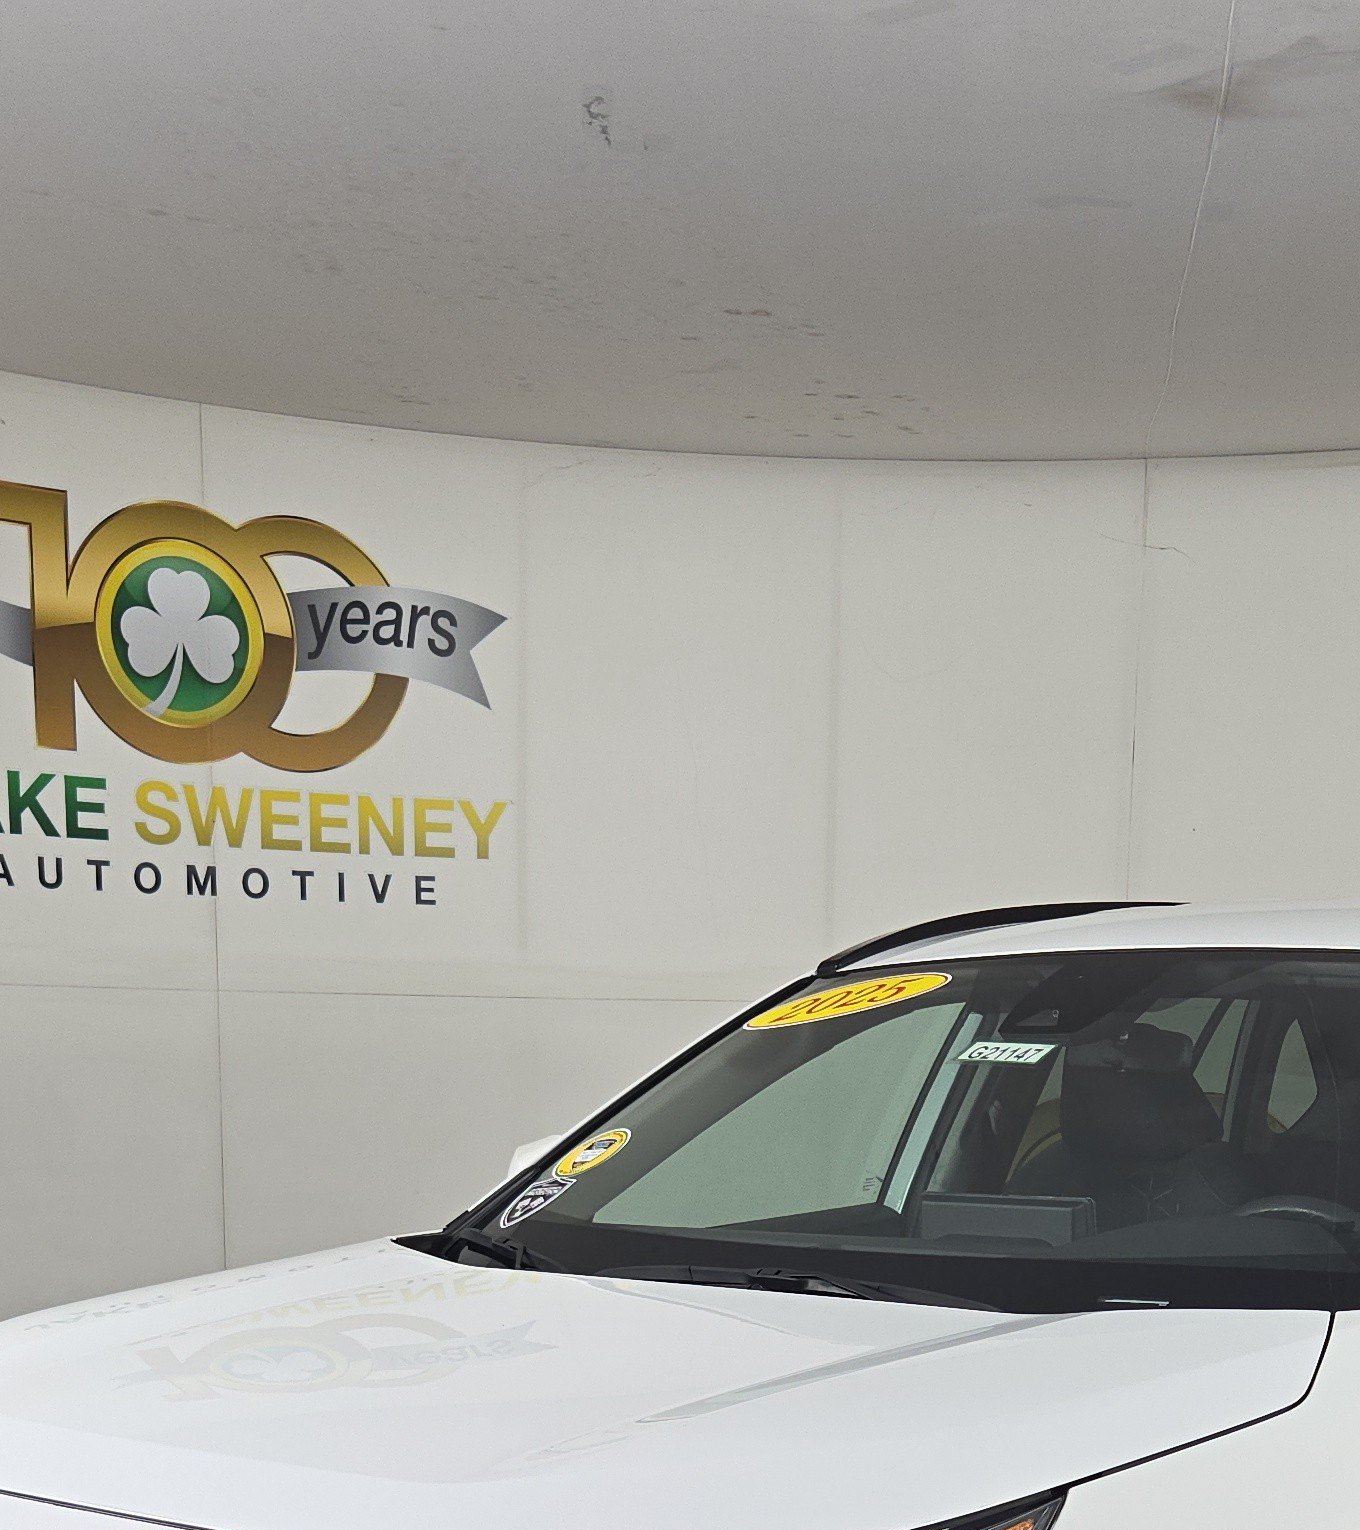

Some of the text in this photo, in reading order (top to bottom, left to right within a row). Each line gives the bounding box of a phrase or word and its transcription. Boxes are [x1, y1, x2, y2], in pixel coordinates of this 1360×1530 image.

[307, 599, 458, 659] years
[134, 781, 509, 860] SWEENEY
[770, 977, 924, 1023] 2025
[968, 1046, 1044, 1062] G21147
